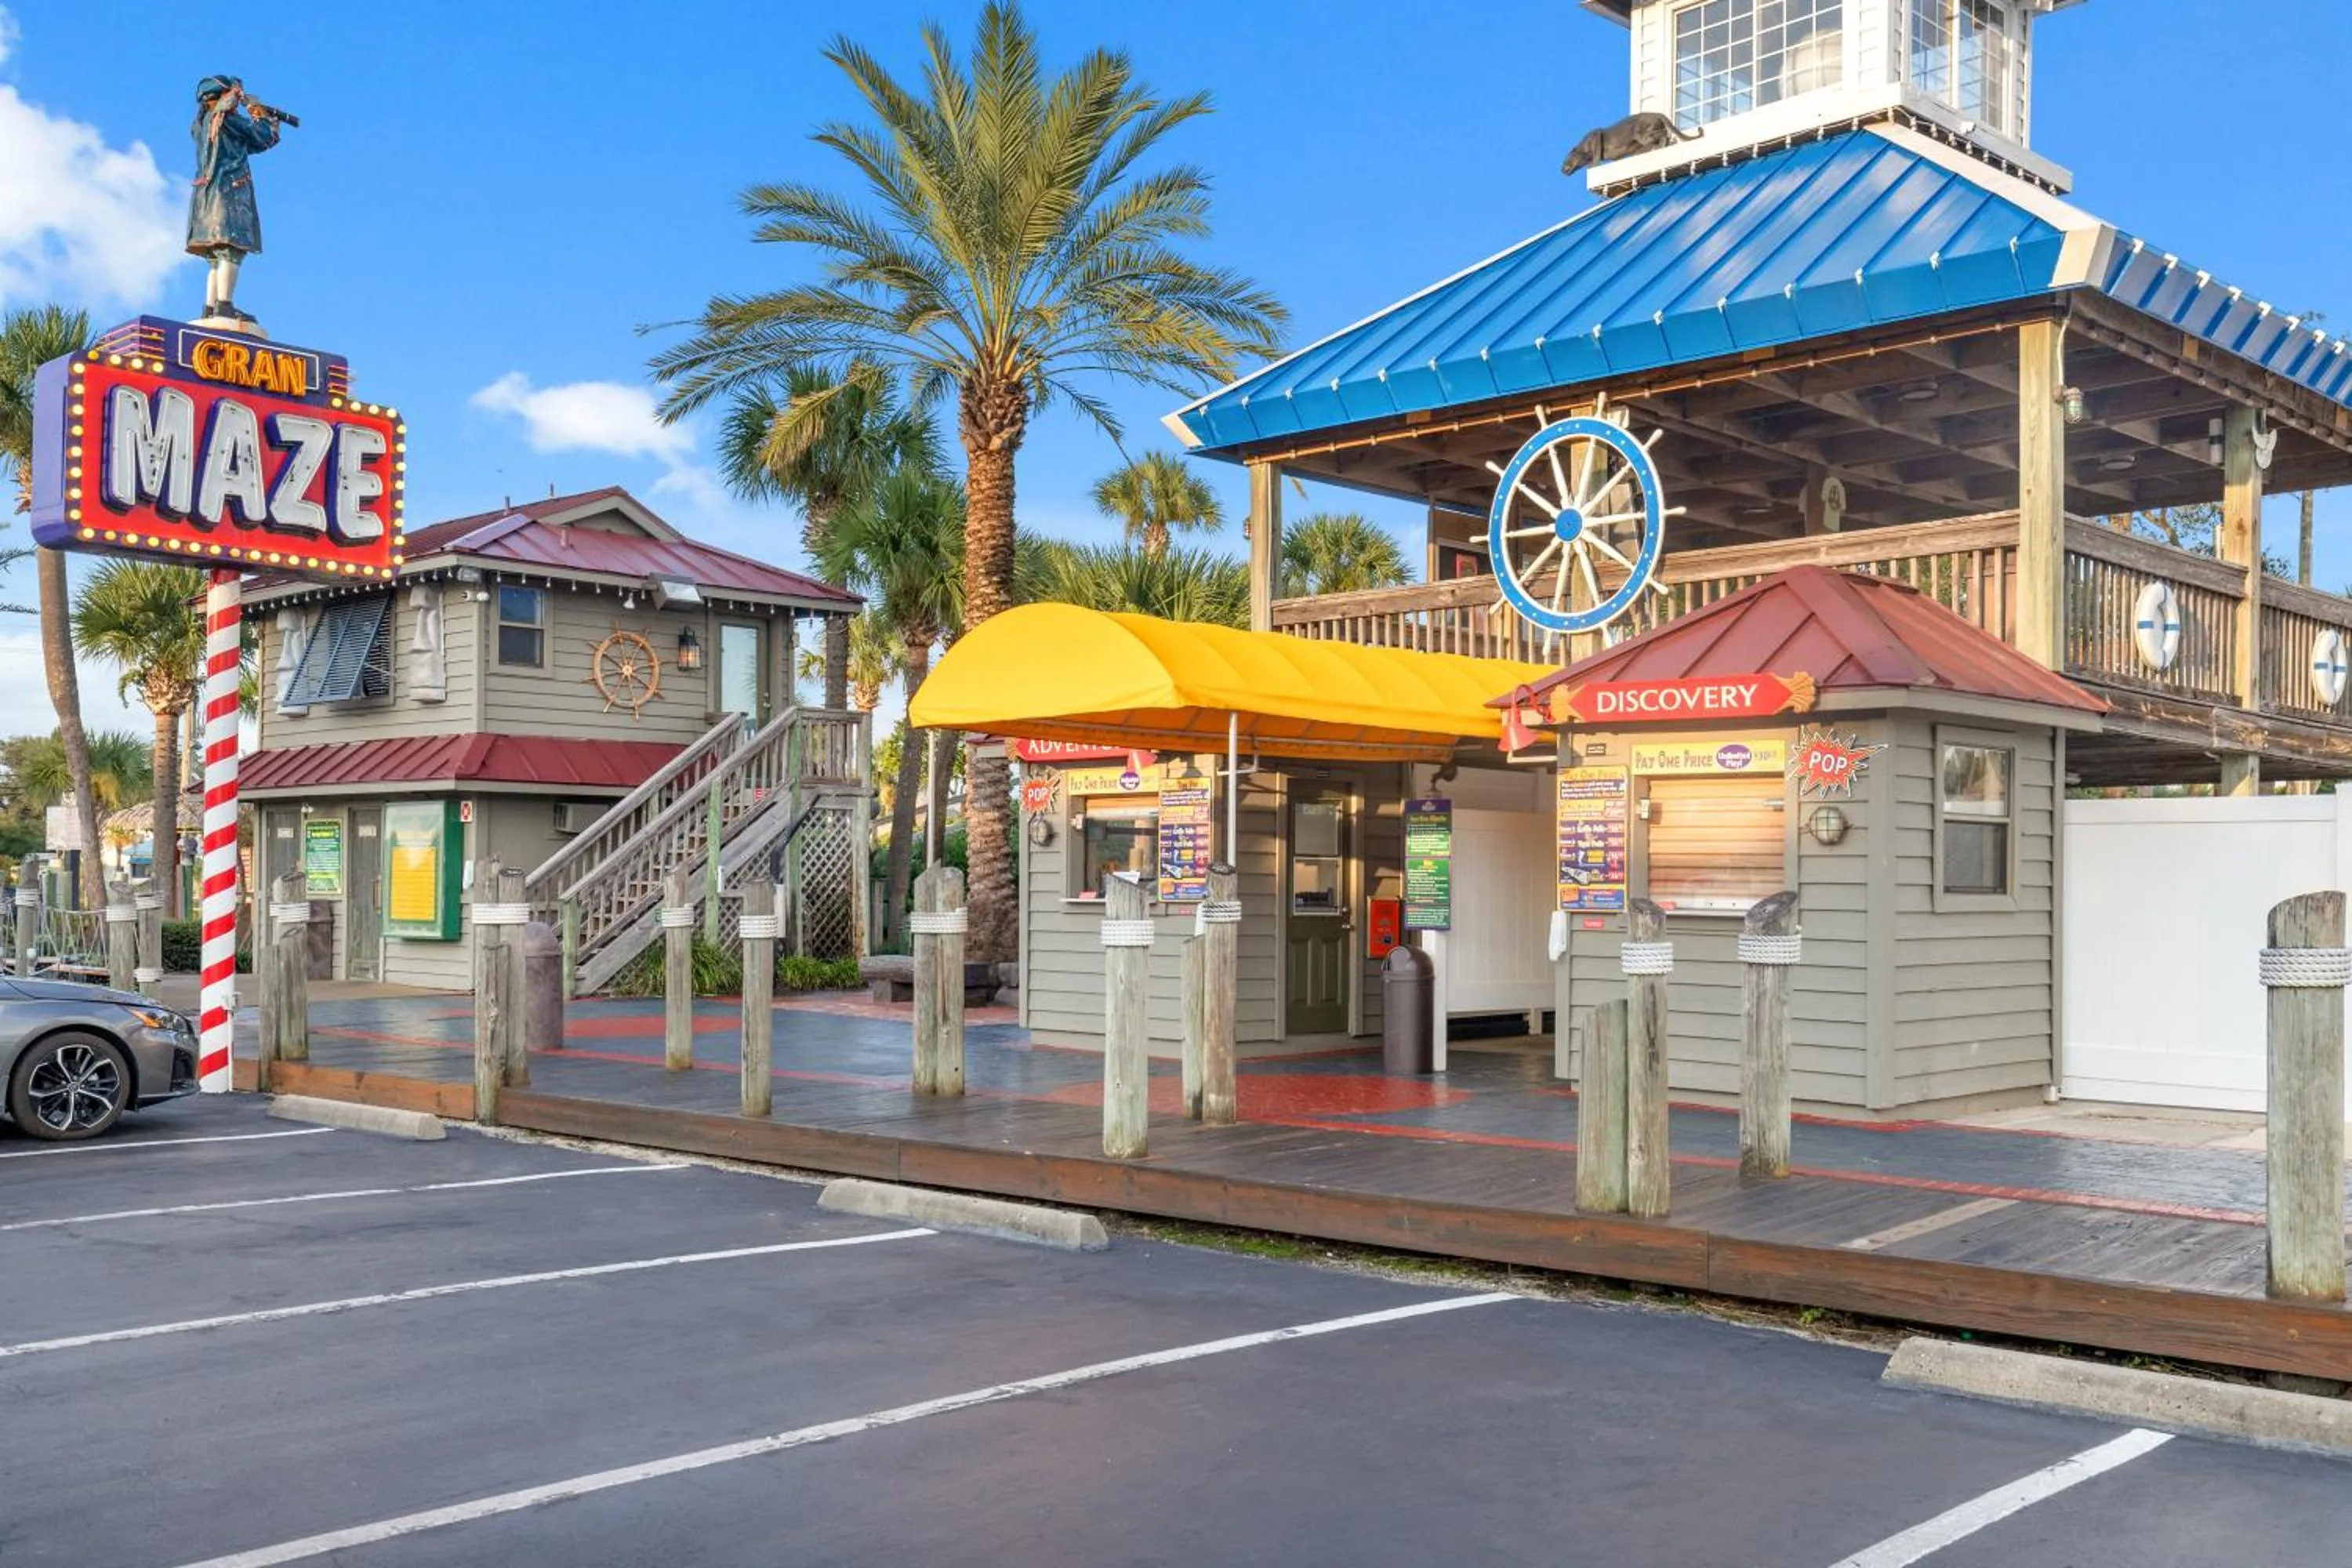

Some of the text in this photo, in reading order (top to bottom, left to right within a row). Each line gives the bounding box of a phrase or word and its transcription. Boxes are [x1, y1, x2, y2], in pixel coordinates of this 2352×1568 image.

[192, 338, 307, 397] GRAN
[102, 384, 387, 546] MAZE
[1596, 684, 1758, 713] DISCOVERY
[1635, 749, 1713, 769] PAY ONE PRICE
[1809, 750, 1848, 775] POP
[1028, 787, 1048, 803] POP
